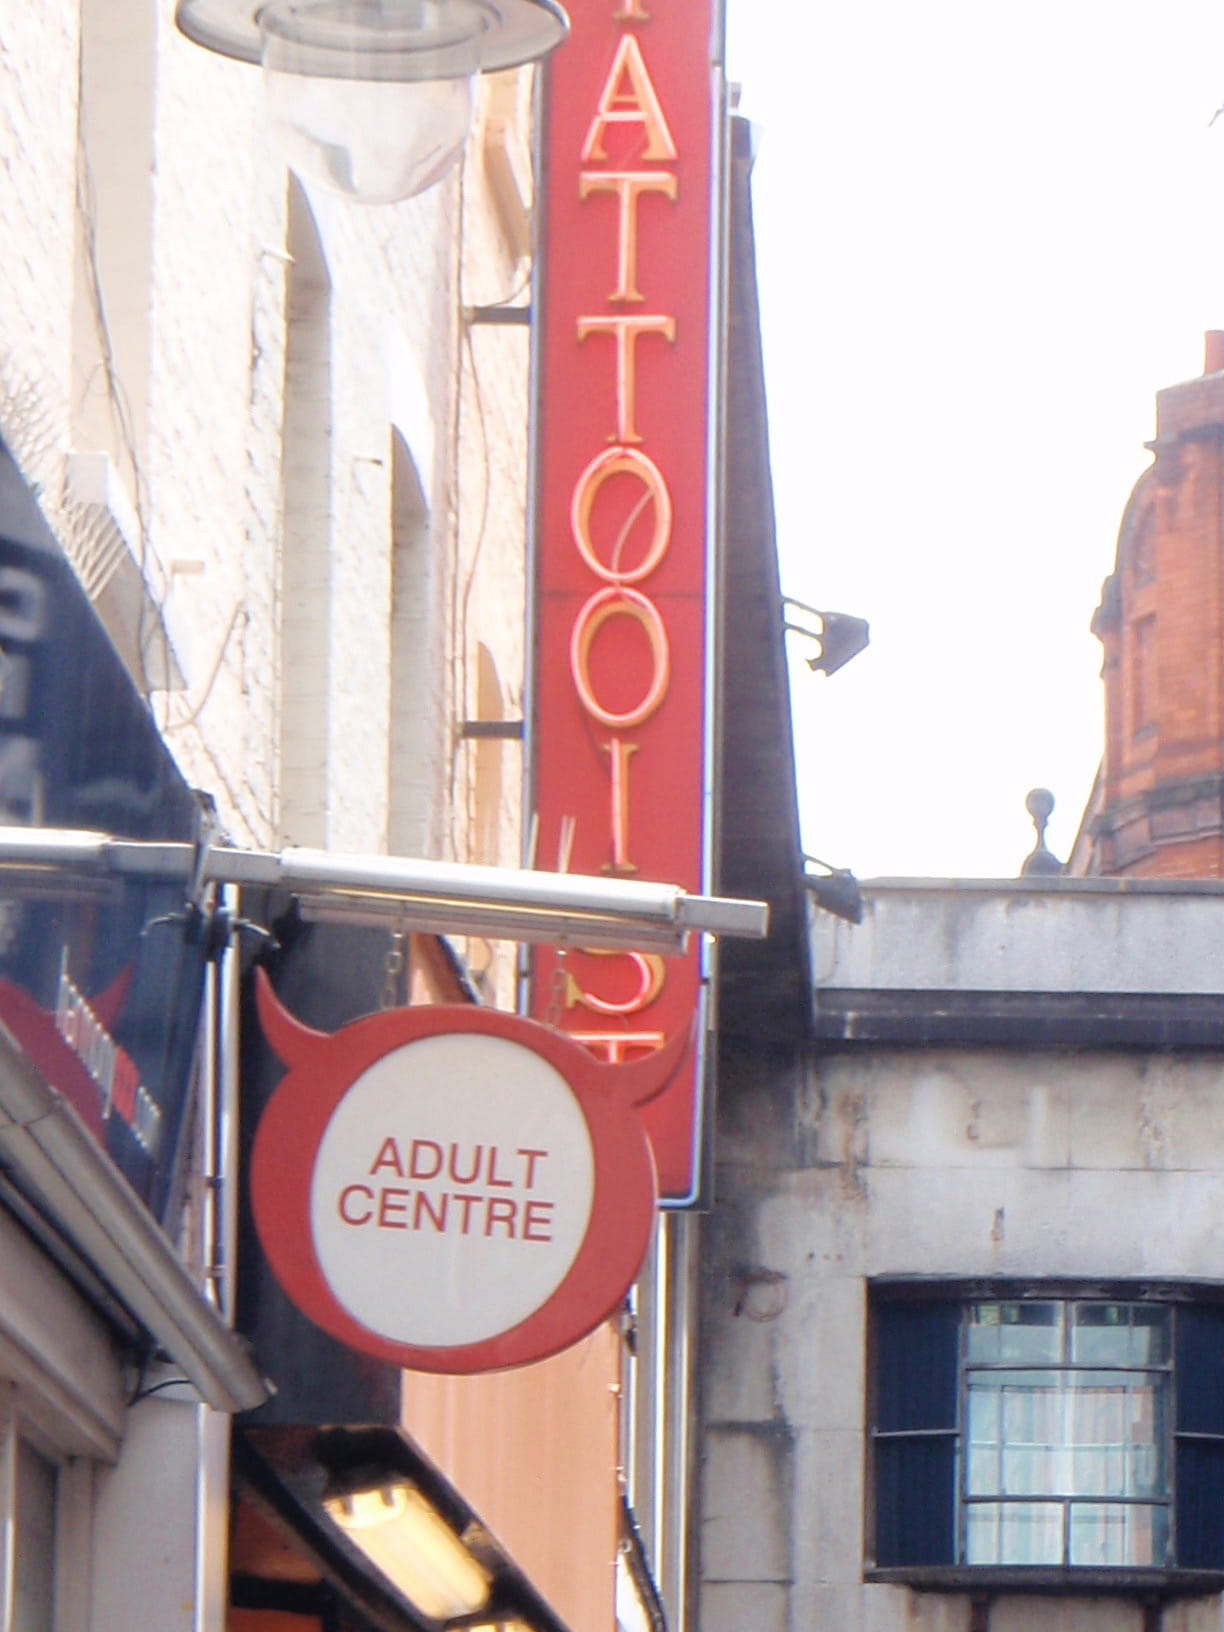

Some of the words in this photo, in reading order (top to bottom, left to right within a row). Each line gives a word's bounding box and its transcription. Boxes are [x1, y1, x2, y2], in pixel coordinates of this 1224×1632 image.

[569, 0, 679, 1065] ATTOOIS
[370, 1137, 548, 1190] ADULT
[337, 1184, 555, 1243] CENTRE
